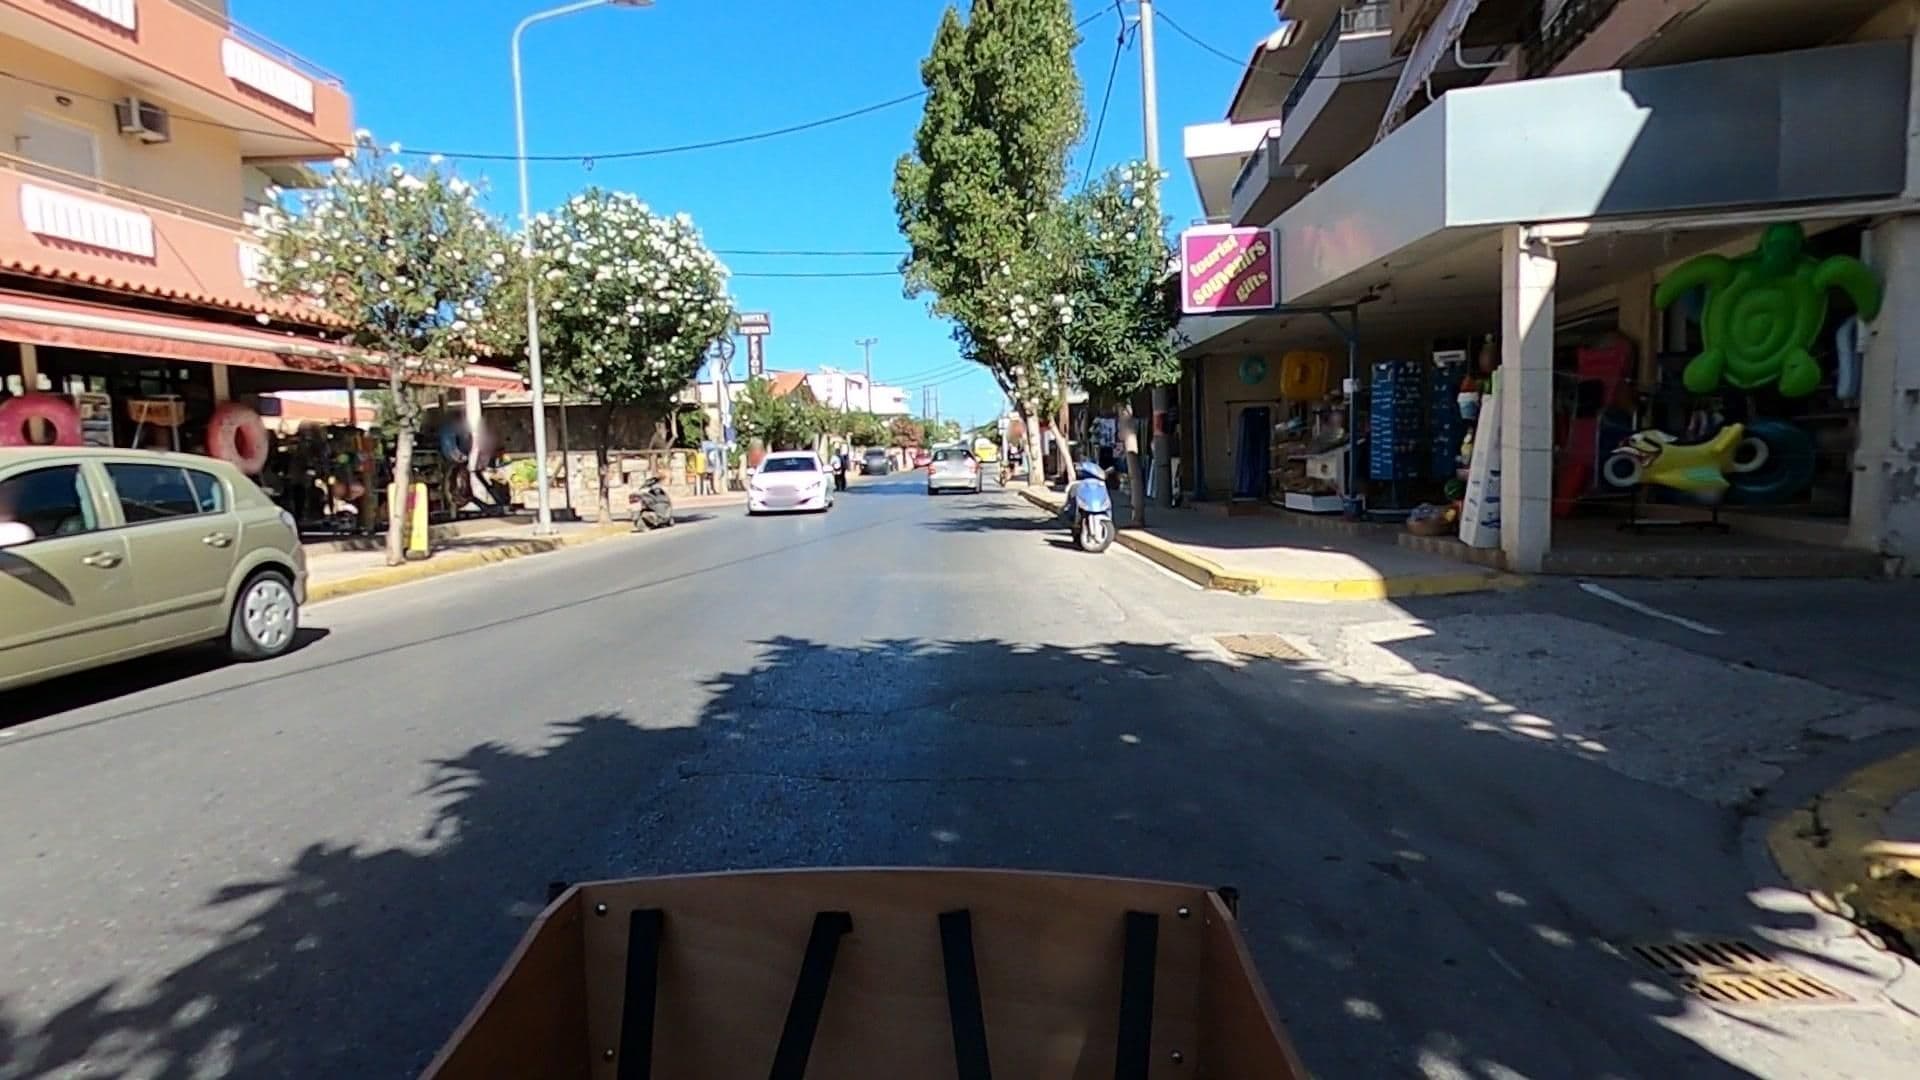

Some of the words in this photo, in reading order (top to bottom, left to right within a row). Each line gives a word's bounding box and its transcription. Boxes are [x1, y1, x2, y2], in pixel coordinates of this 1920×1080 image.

[1190, 234, 1238, 277] tourist
[1193, 240, 1267, 305] souvenirs
[1236, 272, 1268, 302] gifts
